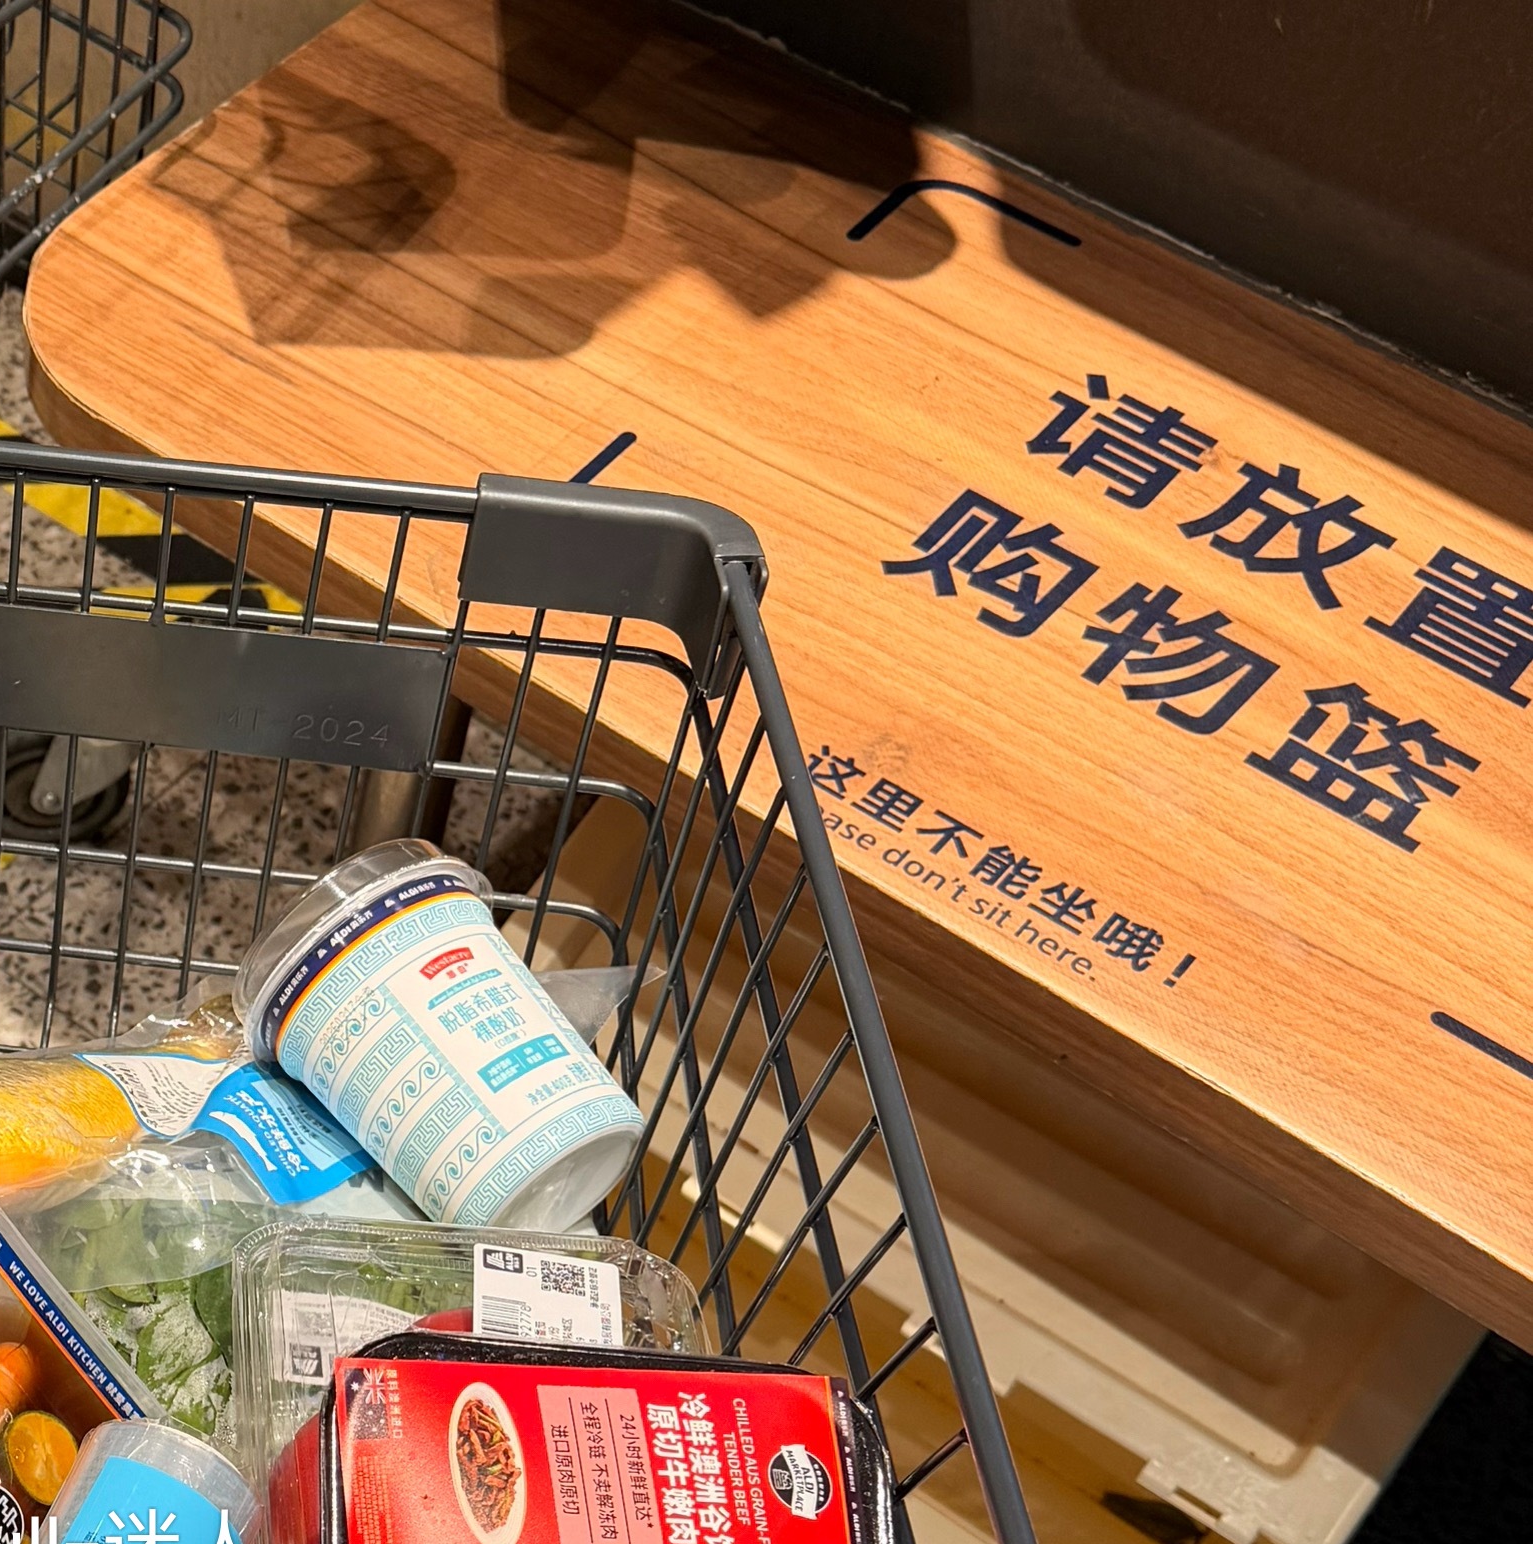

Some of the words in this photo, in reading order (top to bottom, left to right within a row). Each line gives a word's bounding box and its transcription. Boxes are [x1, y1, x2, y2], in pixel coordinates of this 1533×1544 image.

[1025, 374, 1533, 709] 请放置
[881, 489, 1480, 854] 购物篮
[293, 714, 390, 747] 2024
[882, 847, 969, 901] don't
[969, 894, 1012, 927] sit
[1014, 918, 1097, 982] here.
[223, 1093, 267, 1132] AQUATIC
[236, 1089, 310, 1172] 冷鲜水产
[262, 1129, 297, 1178] CHILLED
[7, 1261, 27, 1282] WE
[21, 1279, 50, 1311] LOVE
[44, 1308, 71, 1337] ALDI
[65, 1335, 109, 1385] KITCHEN
[579, 1401, 605, 1461] 全程冷链
[723, 1431, 745, 1486] TENDER
[732, 1397, 755, 1455] CHILLED
[744, 1457, 761, 1485] AUS
[549, 1423, 580, 1516] 进口原肉原切
[591, 1462, 618, 1542] 不卖解冻肉
[786, 1450, 803, 1512] MARKETPLACE
[801, 1466, 815, 1494] ALDI
[732, 1488, 751, 1526] BEEF
